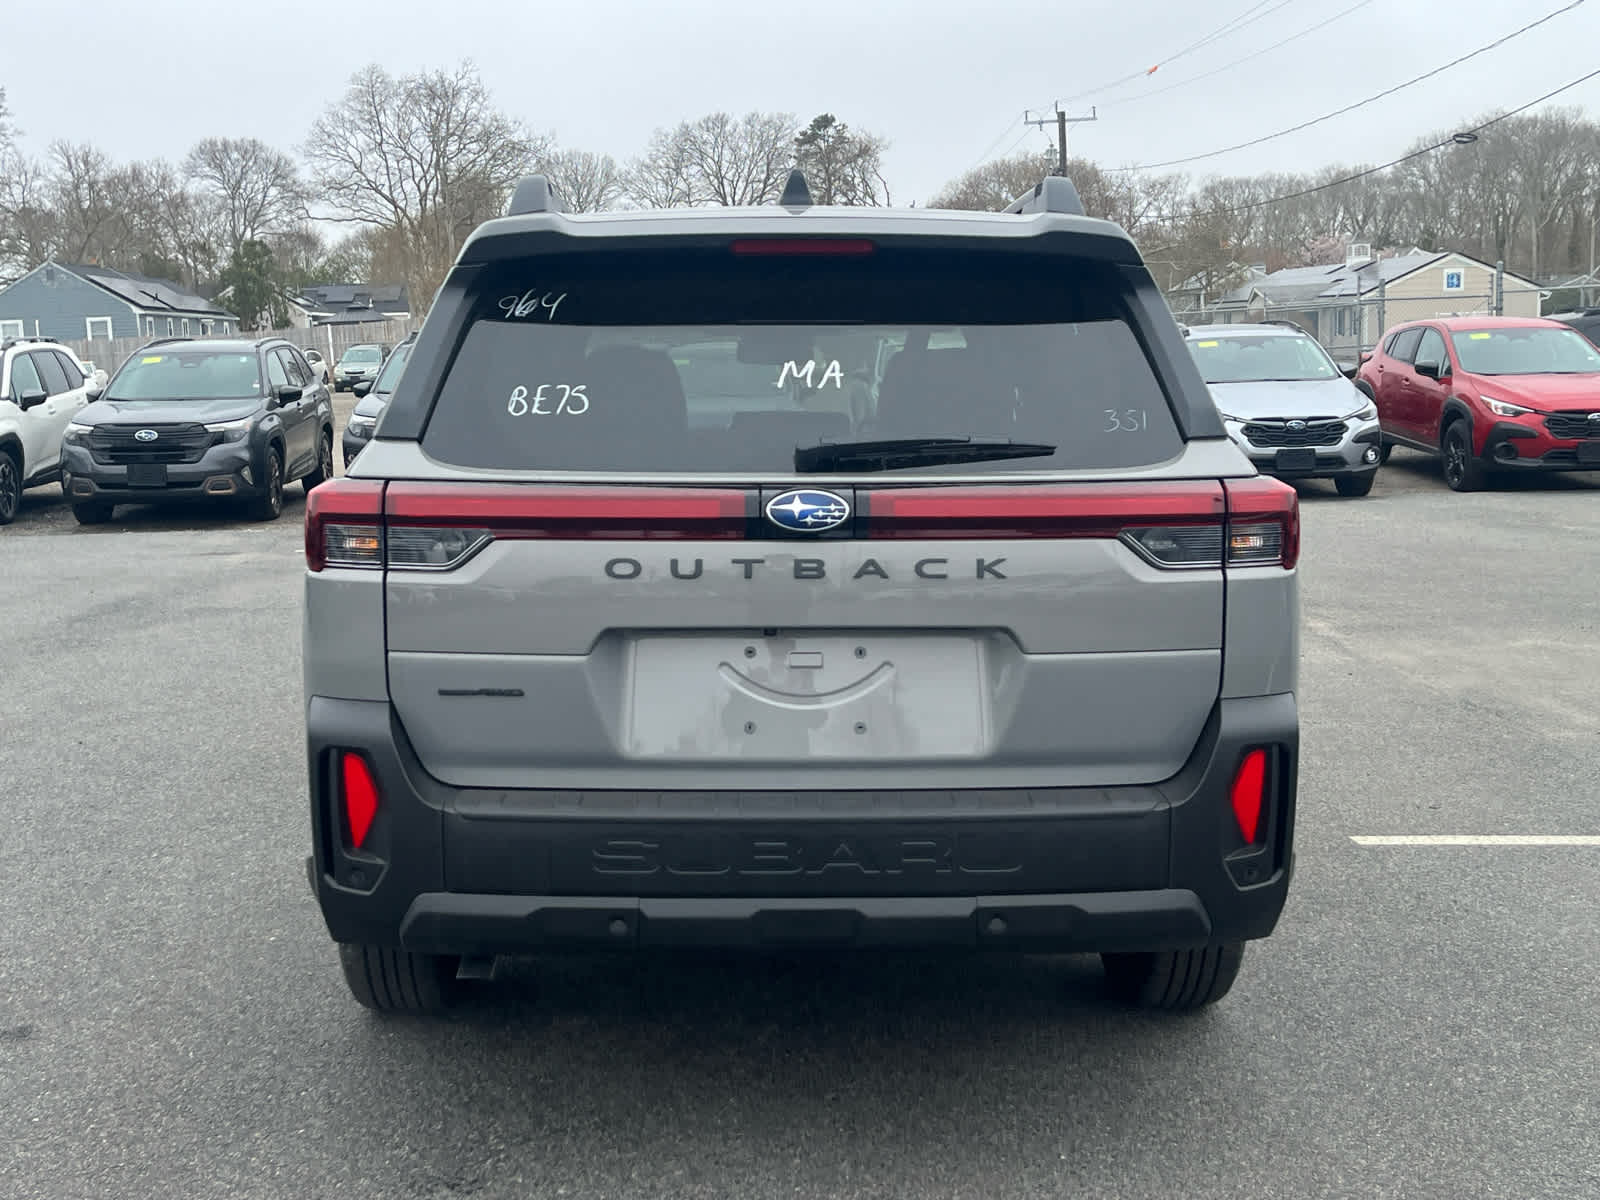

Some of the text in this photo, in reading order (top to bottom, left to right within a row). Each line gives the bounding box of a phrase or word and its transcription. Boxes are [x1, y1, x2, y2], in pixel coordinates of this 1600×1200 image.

[776, 359, 845, 389] MA
[603, 557, 1008, 580] OUTBACK
[592, 840, 1023, 875] SUBARU
